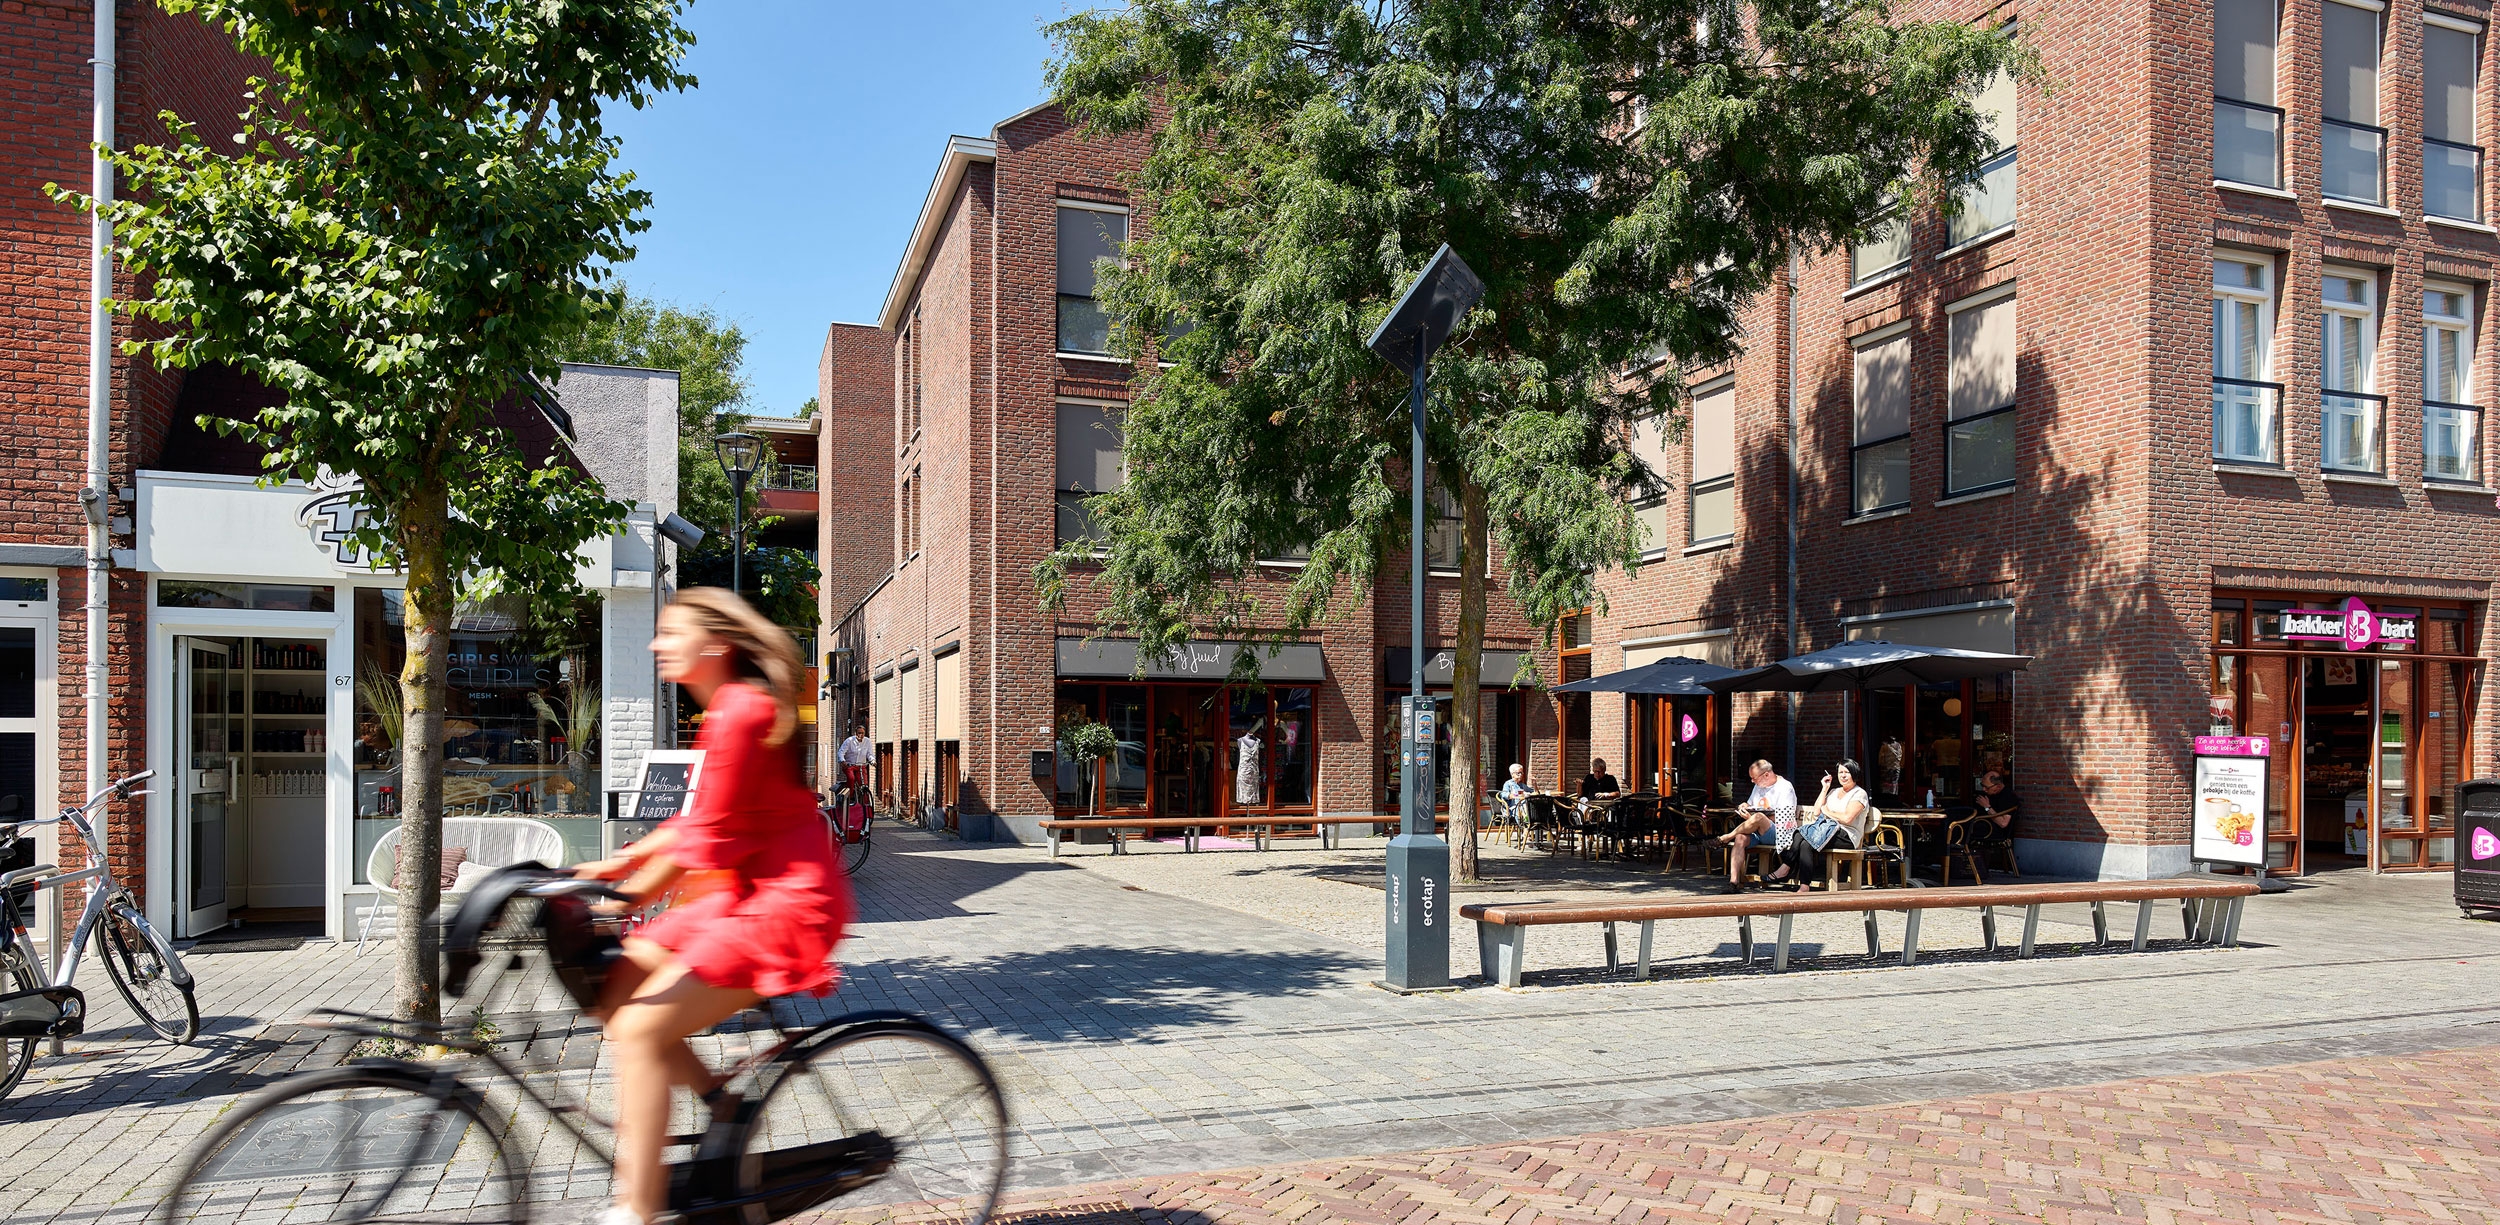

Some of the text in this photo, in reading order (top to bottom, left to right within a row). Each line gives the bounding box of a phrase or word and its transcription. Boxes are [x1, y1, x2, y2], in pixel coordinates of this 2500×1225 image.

[2284, 610, 2415, 643] bakker B bart
[446, 653, 499, 666] GIRLS
[1190, 645, 1221, 673] Juud
[335, 675, 351, 686] 67
[445, 667, 551, 691] CURLS
[1392, 875, 1400, 924] ecotap
[1421, 878, 1435, 926] ecotap
[229, 1179, 258, 1187] SINT
